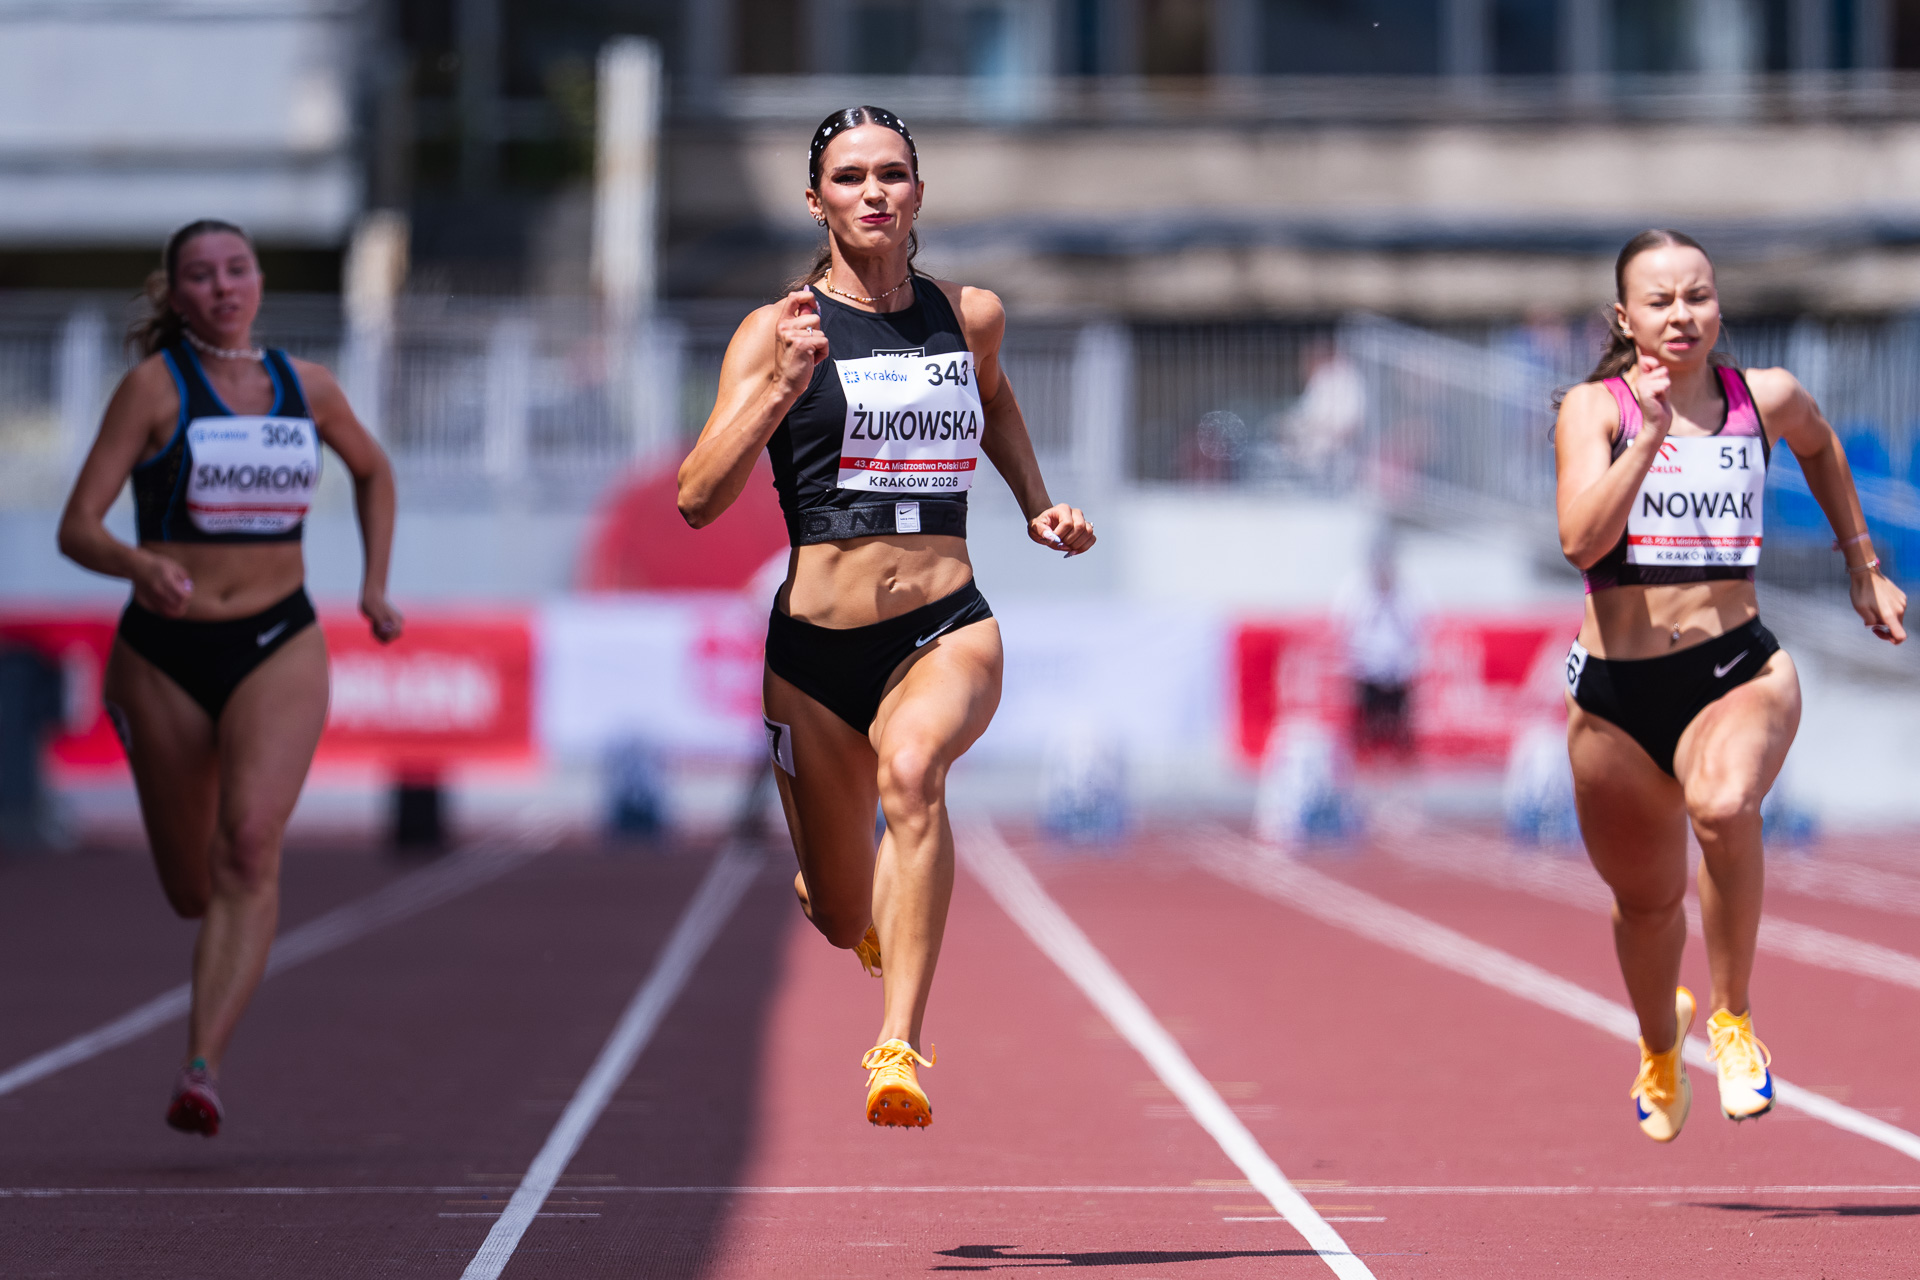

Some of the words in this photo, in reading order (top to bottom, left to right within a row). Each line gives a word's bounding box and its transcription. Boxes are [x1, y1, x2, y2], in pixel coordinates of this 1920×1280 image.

[864, 370, 908, 382] Kraków
[925, 360, 968, 387] 343
[850, 403, 977, 441] ŻUKOWSKA
[261, 423, 305, 447] 306
[854, 460, 868, 468] 43.
[869, 461, 891, 470] PZLA
[891, 462, 936, 471] Mistrzostwa
[937, 461, 959, 470] Polski
[1648, 465, 1682, 474] ORLEN
[1720, 446, 1750, 470] 51
[196, 461, 311, 491] SMOROŃ
[869, 474, 929, 488] KRAKÓW
[931, 477, 958, 487] 2026
[1642, 492, 1754, 519] NOWAK
[1567, 654, 1580, 685] 6
[764, 719, 782, 764] 7
